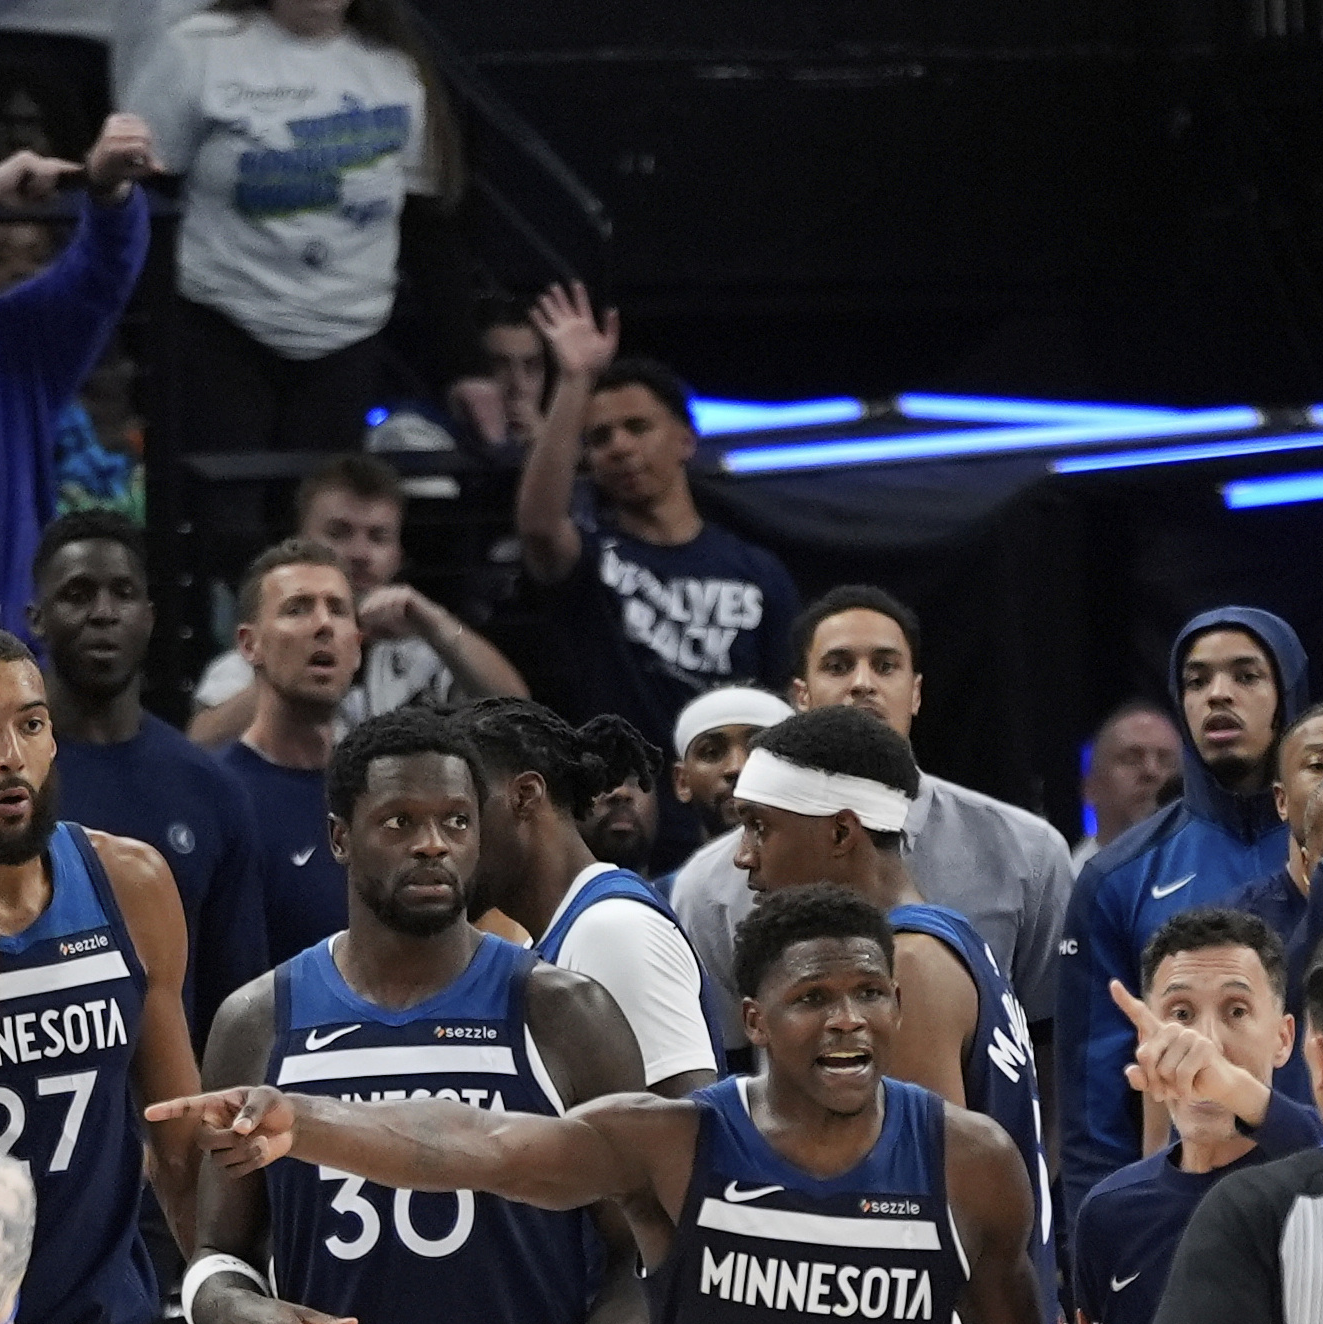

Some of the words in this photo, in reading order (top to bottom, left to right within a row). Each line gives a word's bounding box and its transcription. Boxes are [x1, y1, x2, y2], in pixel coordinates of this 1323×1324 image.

[68, 934, 109, 955] sezzle
[445, 1025, 498, 1040] sezzle
[318, 1164, 476, 1261] 30
[871, 1200, 921, 1216] sezzle
[700, 1246, 933, 1320] MINNESOTA
